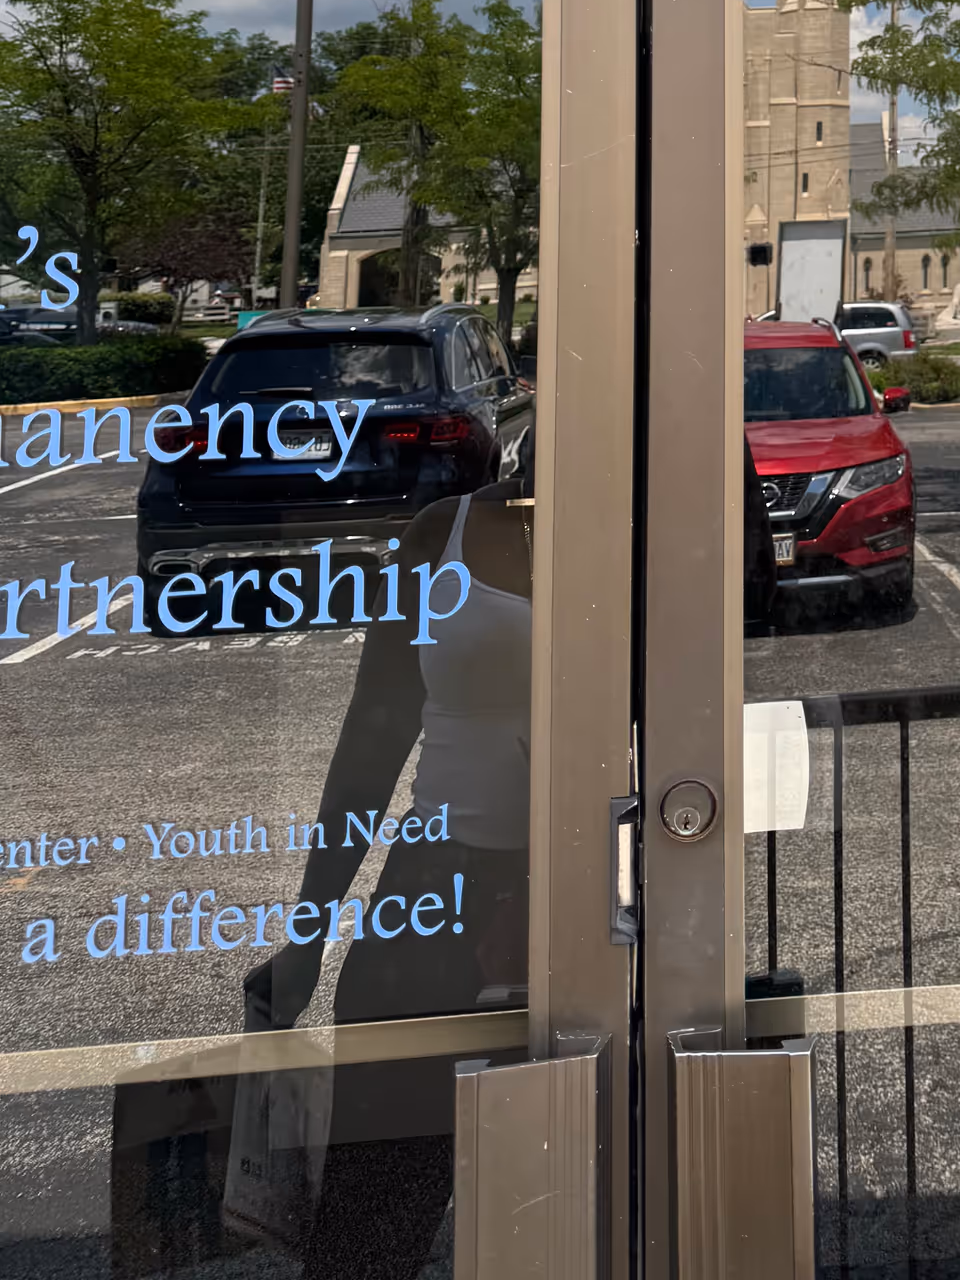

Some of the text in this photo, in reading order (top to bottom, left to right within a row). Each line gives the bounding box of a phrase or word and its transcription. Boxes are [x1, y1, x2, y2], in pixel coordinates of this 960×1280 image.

[0, 225, 80, 310] 's
[143, 815, 270, 860] Youth
[287, 812, 326, 852] in
[341, 803, 451, 847] Need
[21, 872, 466, 964] a difference!
